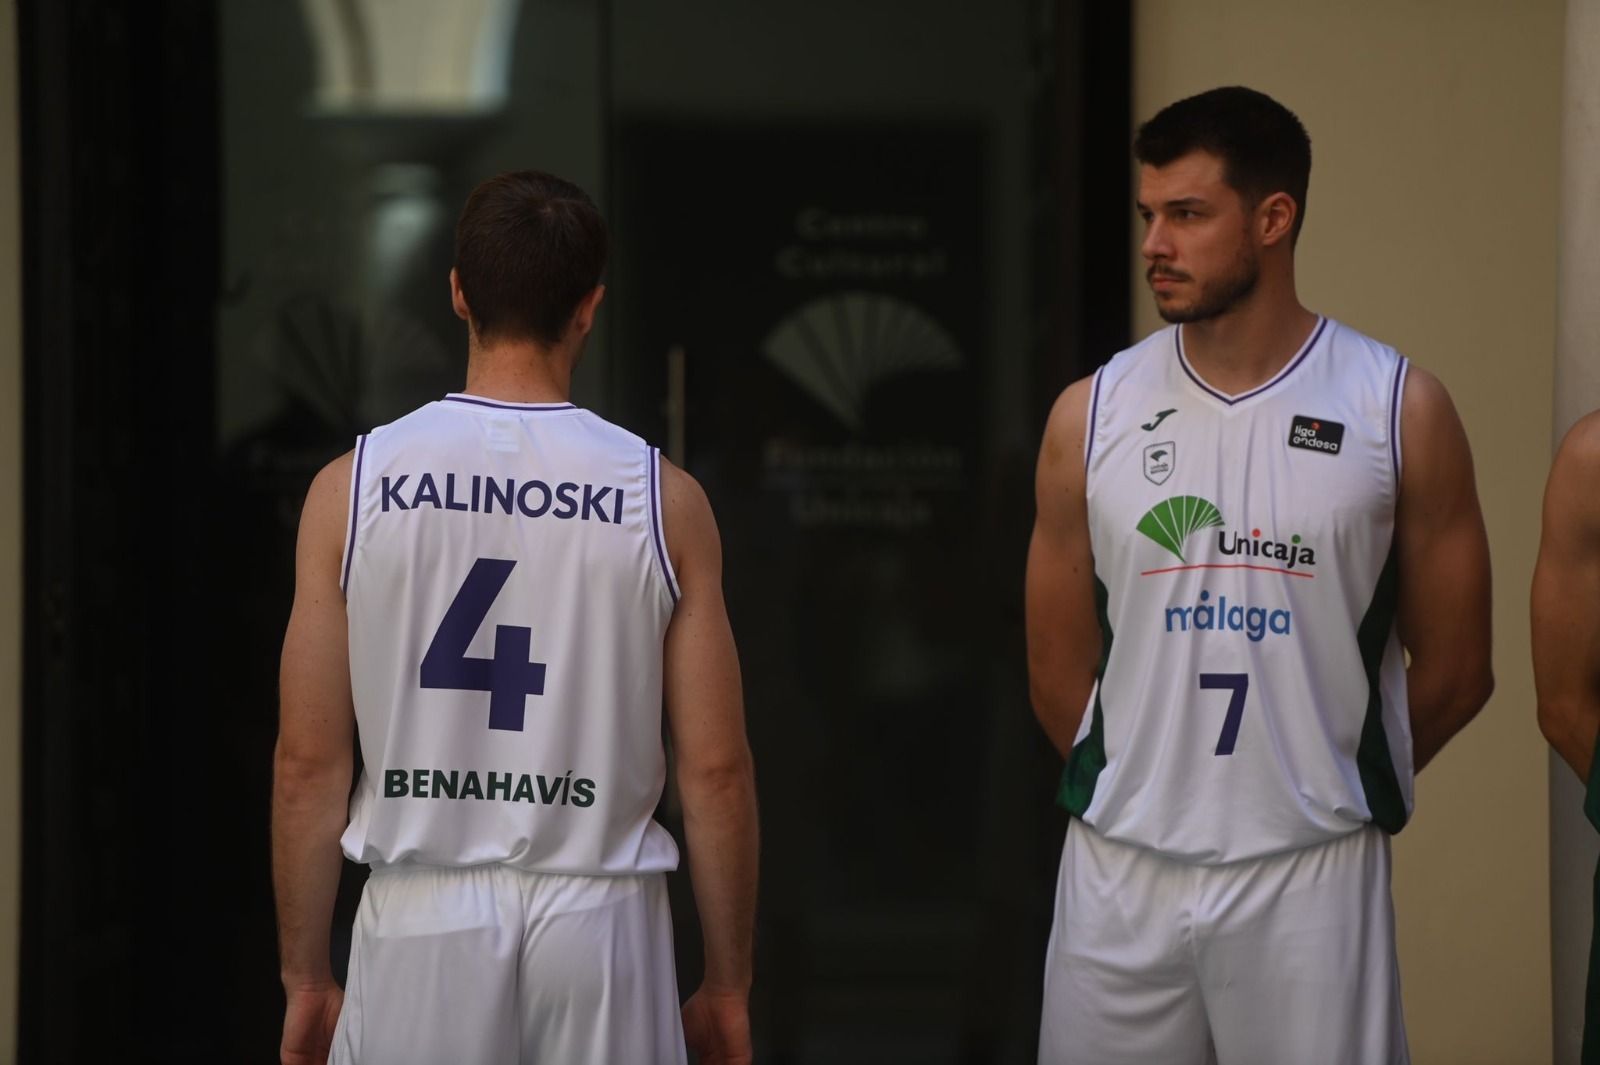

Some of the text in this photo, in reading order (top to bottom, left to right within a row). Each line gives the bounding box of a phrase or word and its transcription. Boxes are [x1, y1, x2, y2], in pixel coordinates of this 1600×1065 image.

[1292, 435, 1339, 452] endesa
[1295, 424, 1317, 438] liga
[380, 472, 625, 525] KALINOSKI
[1218, 527, 1316, 569] Unicaja
[1165, 589, 1291, 643] málaga
[419, 557, 547, 733] 4
[1199, 672, 1249, 757] 7
[383, 768, 597, 809] BENAHAVÍS
